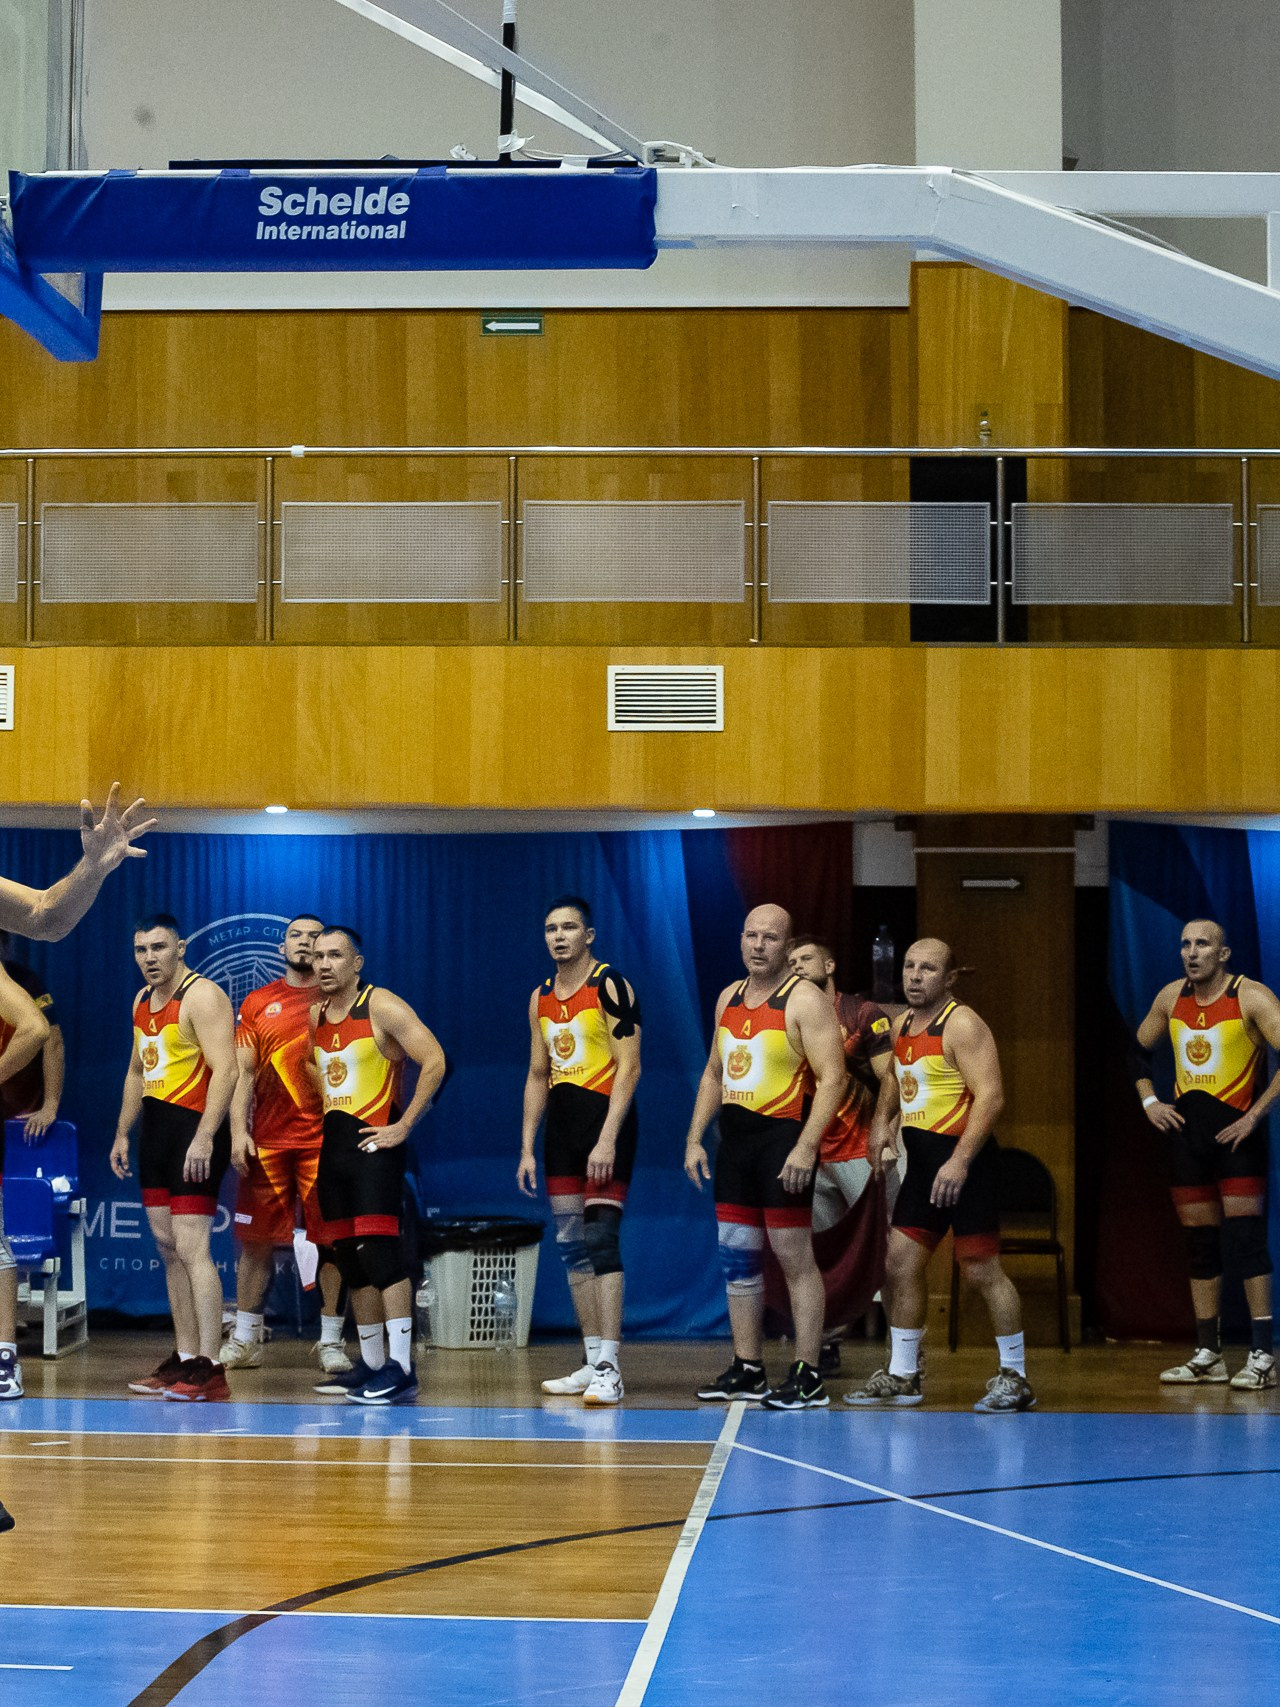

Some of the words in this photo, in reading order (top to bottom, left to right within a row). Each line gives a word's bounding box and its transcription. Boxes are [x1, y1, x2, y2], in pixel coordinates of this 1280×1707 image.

[258, 186, 410, 216] Schelde
[256, 220, 406, 240] International
[208, 926, 251, 946] МЕТАР
[263, 926, 287, 940] СПО
